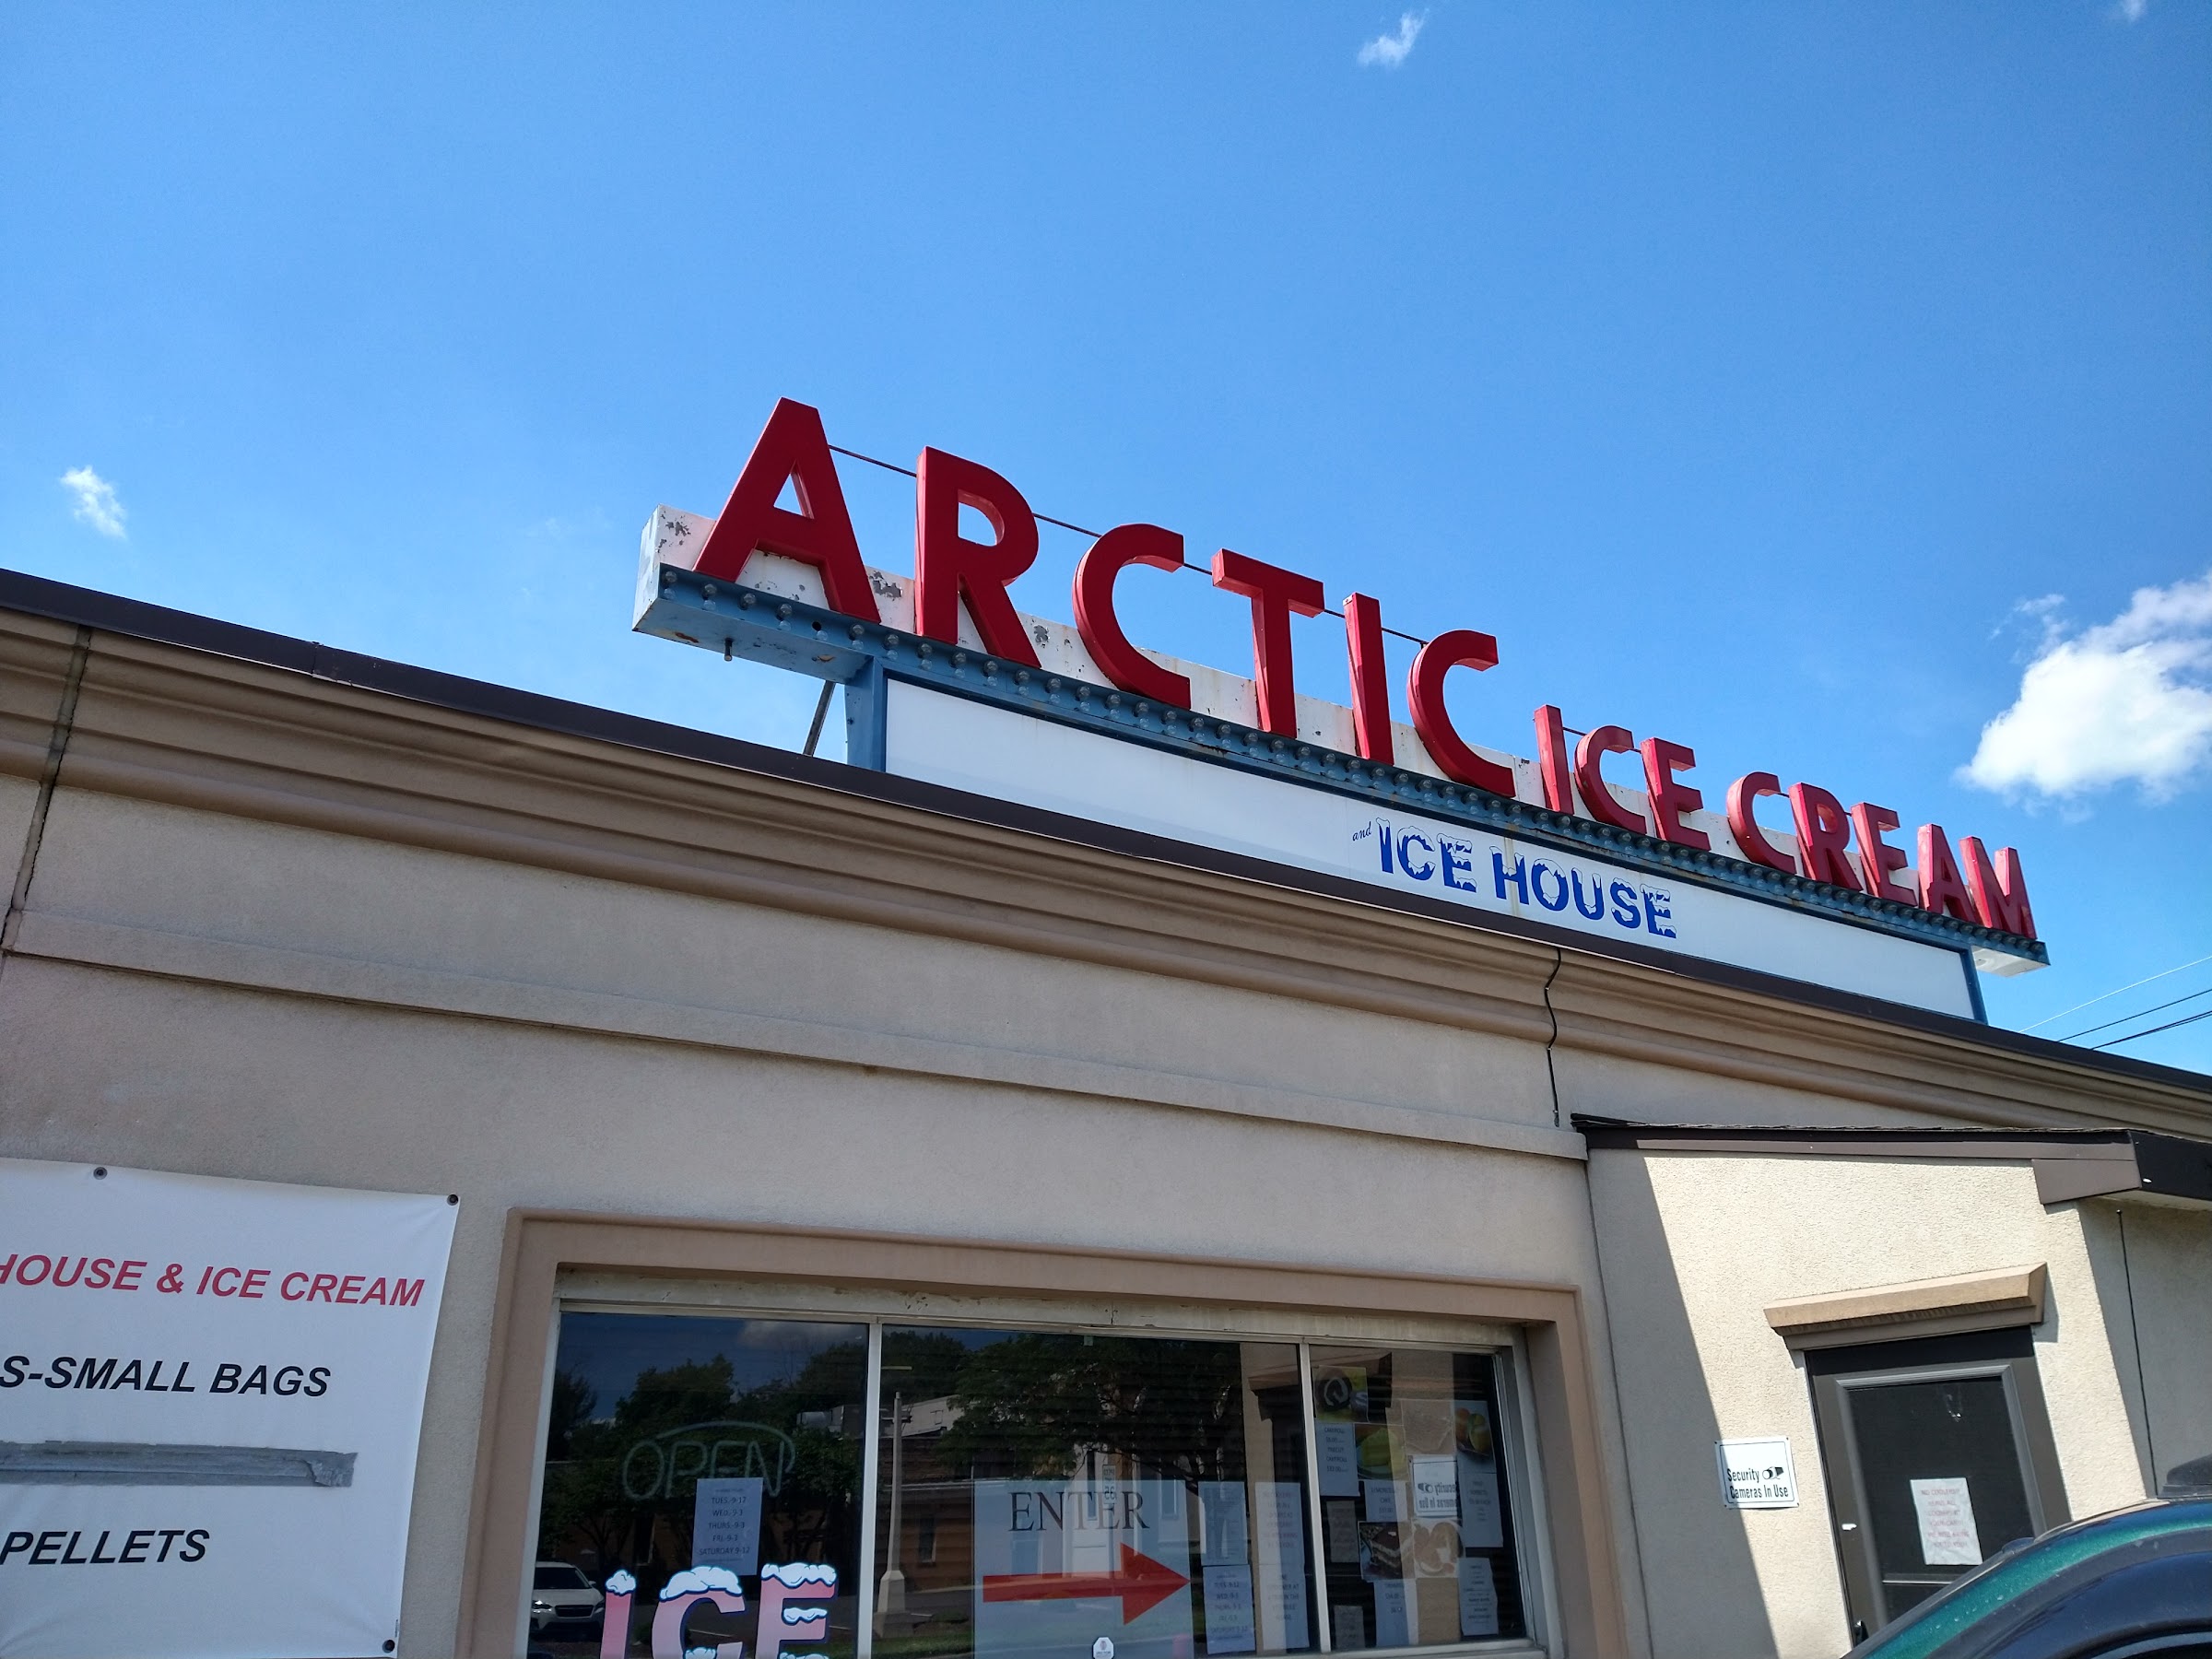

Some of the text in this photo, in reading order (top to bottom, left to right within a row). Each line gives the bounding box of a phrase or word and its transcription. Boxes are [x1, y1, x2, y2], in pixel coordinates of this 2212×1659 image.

[693, 397, 2038, 939] ARCTIC ICE CREAM
[1352, 818, 1677, 939] and ICE HOUSE
[157, 1264, 183, 1294] &
[196, 1265, 271, 1299] ICE
[280, 1272, 425, 1307] CREAM
[209, 1364, 332, 1397] BAGS
[622, 1440, 785, 1500] OPEN
[1726, 1467, 1760, 1484] Security
[1007, 1491, 1150, 1532] ENTER
[1729, 1484, 1789, 1500] Cameras In Use
[0, 1529, 210, 1566] PELLETS
[600, 1562, 838, 1659] ICE
